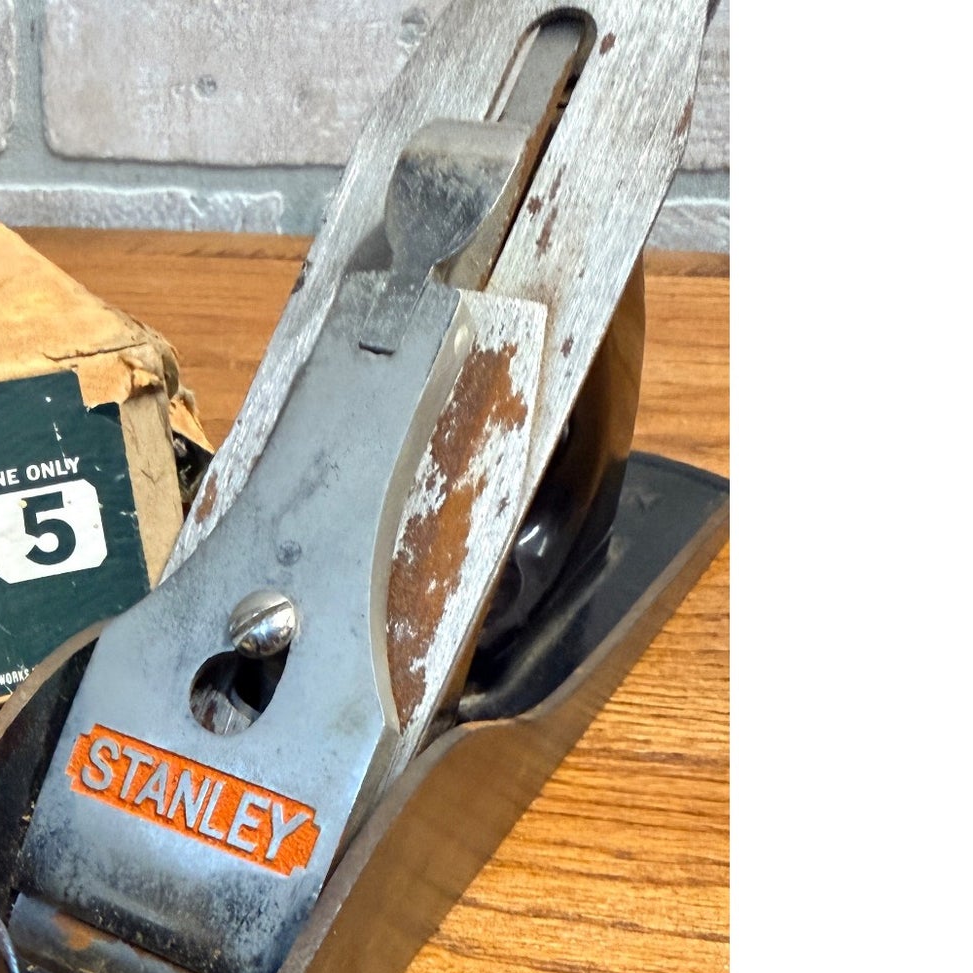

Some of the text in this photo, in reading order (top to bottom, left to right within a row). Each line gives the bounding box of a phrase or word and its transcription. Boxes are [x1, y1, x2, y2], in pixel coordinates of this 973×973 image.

[25, 457, 80, 481] ONLY
[20, 491, 77, 566] 5
[80, 735, 312, 862] STANLEY
